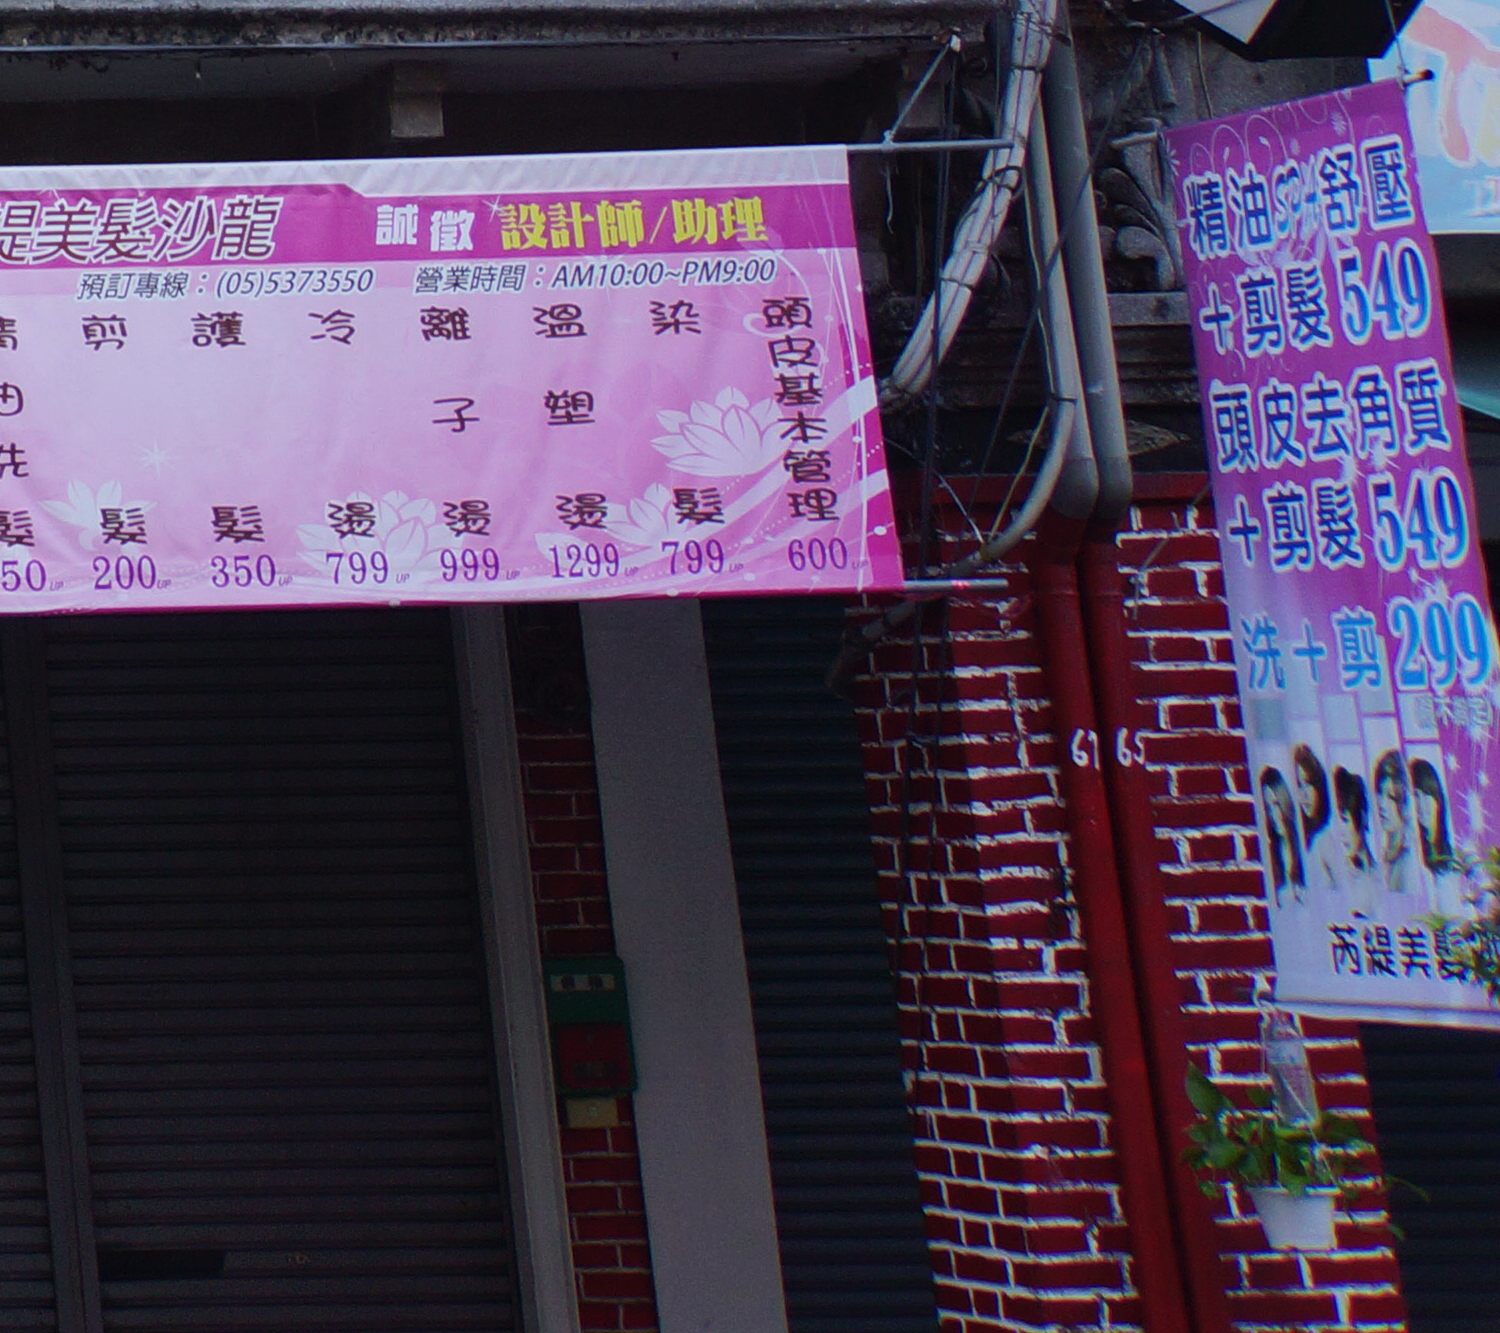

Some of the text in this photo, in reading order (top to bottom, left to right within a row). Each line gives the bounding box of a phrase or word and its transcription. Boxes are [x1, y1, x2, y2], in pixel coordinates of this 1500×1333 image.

[499, 196, 769, 250] 設計師/助理
[210, 554, 276, 588] 350
[325, 551, 389, 585] 799
[440, 547, 500, 582] 999
[550, 542, 620, 578] 1299
[661, 539, 725, 575] 799
[787, 537, 848, 572] 600
[92, 555, 157, 591] 200
